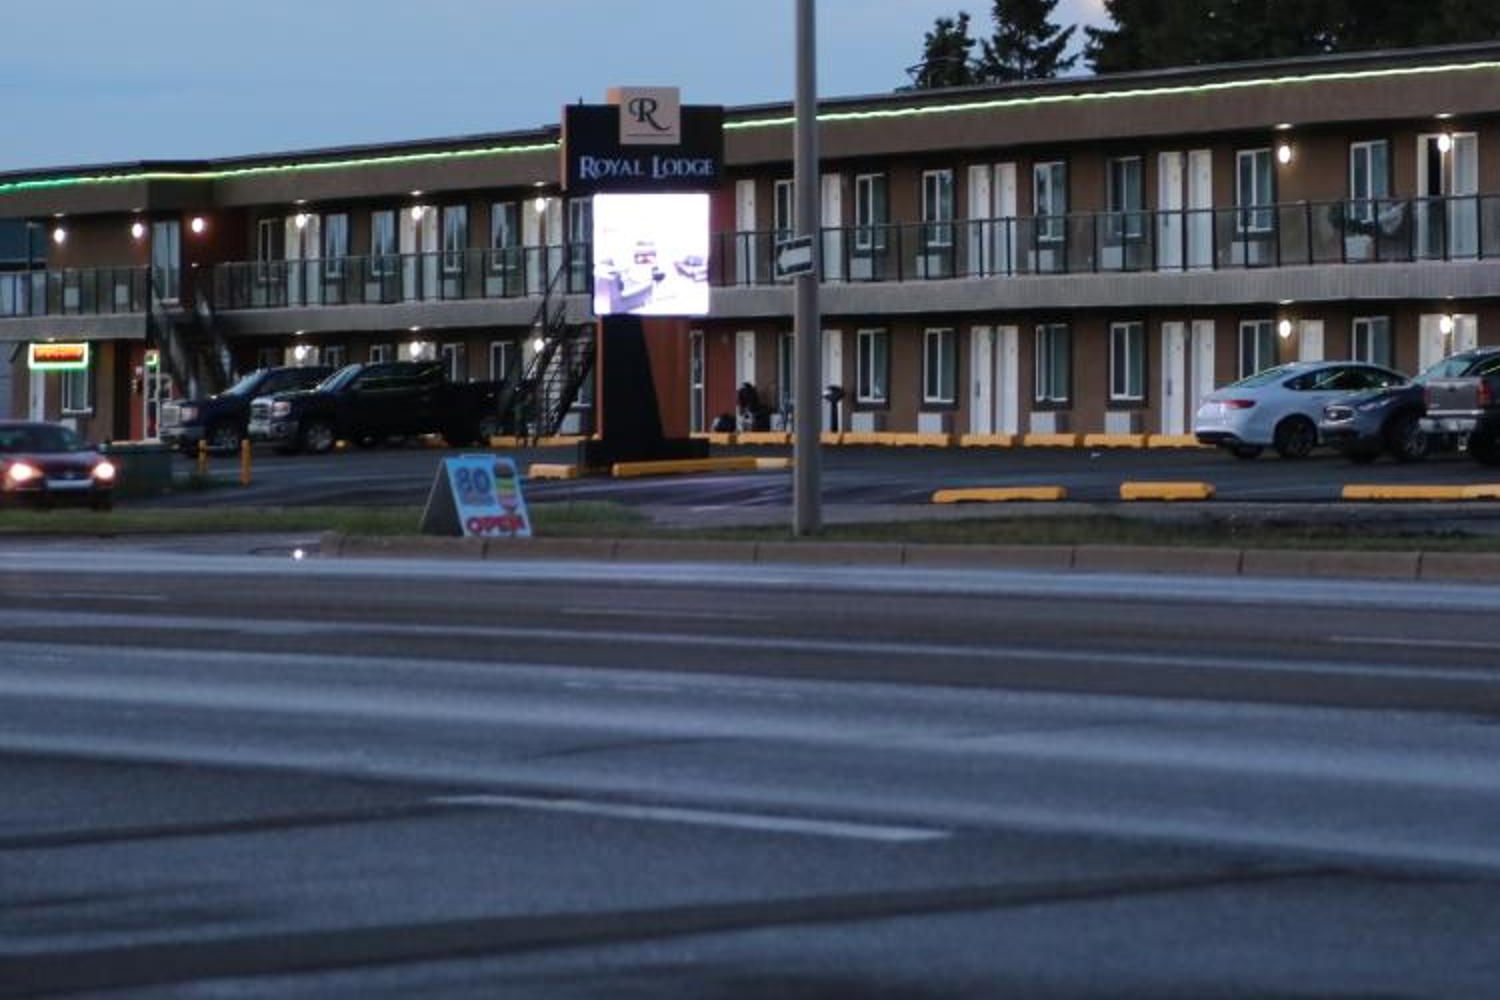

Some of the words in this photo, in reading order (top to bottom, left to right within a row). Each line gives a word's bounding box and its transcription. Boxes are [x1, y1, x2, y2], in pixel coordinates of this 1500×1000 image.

[628, 97, 672, 131] R
[579, 155, 644, 179] ROYAL
[652, 155, 714, 179] LODGE
